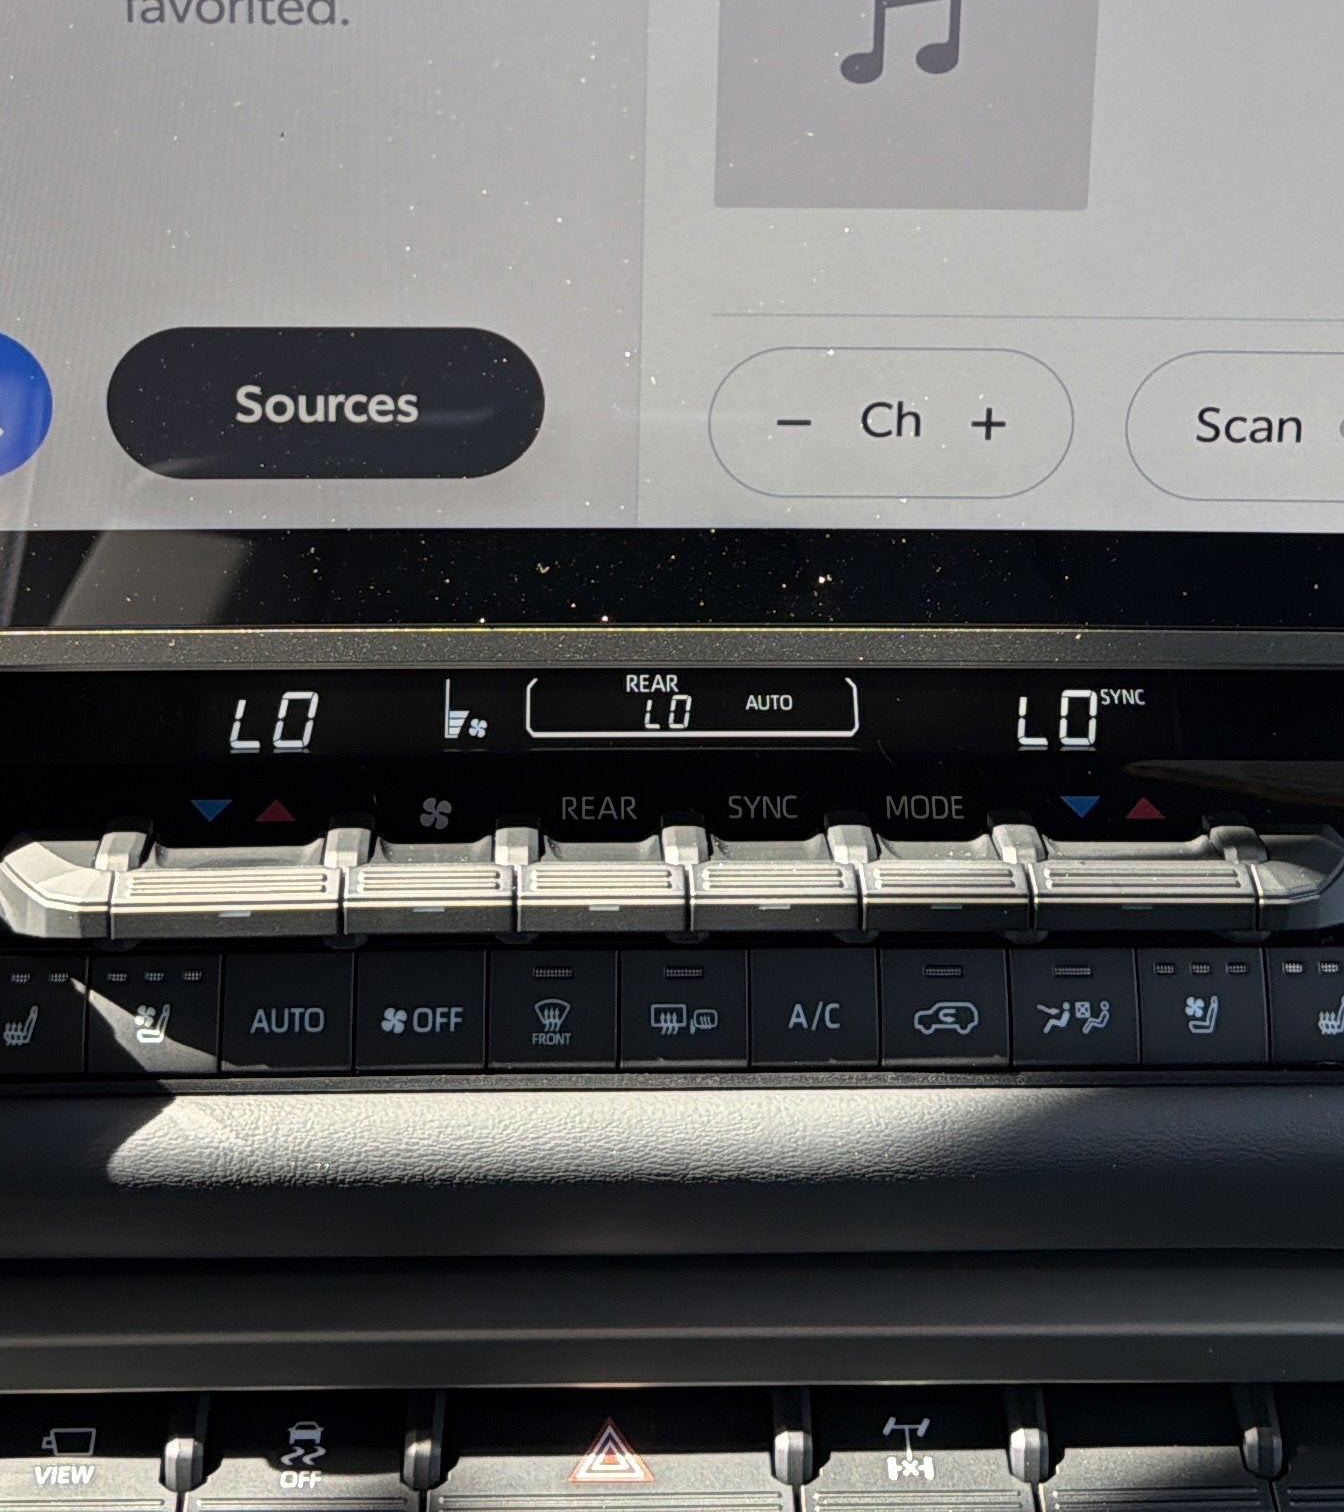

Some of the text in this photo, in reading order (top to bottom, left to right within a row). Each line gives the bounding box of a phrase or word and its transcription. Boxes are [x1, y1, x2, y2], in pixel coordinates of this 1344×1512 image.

[235, 385, 419, 423] Sources
[860, 401, 922, 439] Ch
[1195, 406, 1304, 445] Scan
[625, 674, 680, 694] REAR
[1099, 687, 1147, 707] SYNC
[745, 693, 794, 711] AUTO
[561, 795, 638, 821] REAR
[727, 794, 799, 820] SYNC
[885, 795, 965, 820] MODE
[250, 1007, 325, 1034] AUTO
[412, 1006, 464, 1032] OFF
[787, 1001, 841, 1030] A/C
[531, 1032, 572, 1046] FRONT
[34, 1464, 95, 1487] VIEW
[278, 1469, 323, 1489] OFF
